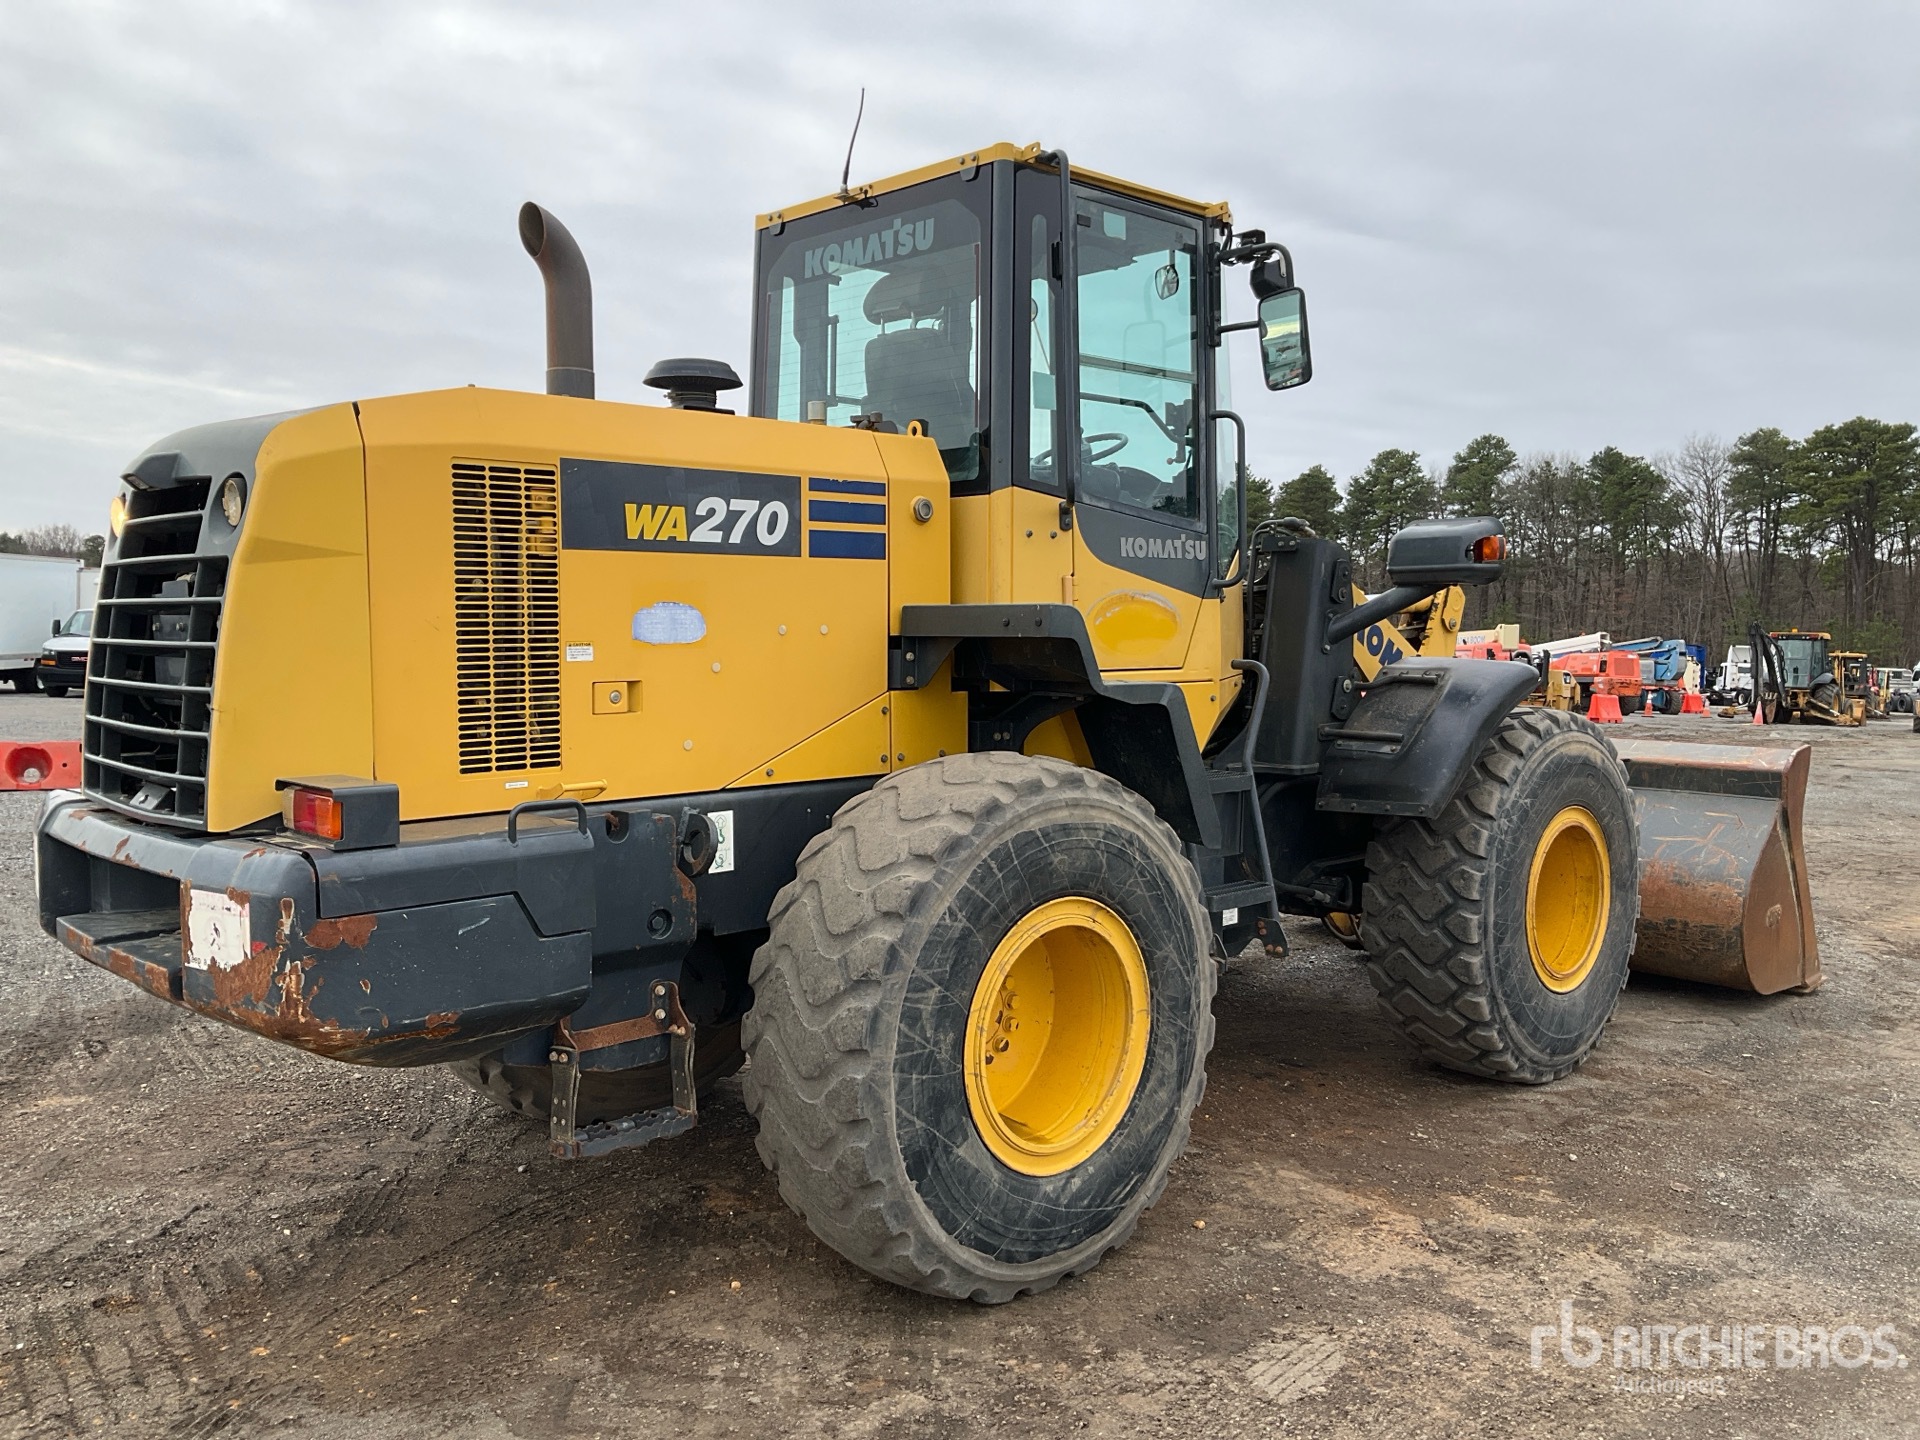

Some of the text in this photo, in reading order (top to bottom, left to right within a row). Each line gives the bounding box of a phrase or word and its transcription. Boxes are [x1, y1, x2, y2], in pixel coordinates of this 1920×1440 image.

[804, 218, 935, 279] KOMATSU
[624, 496, 789, 546] WA270
[1120, 533, 1207, 560] KOMATSU
